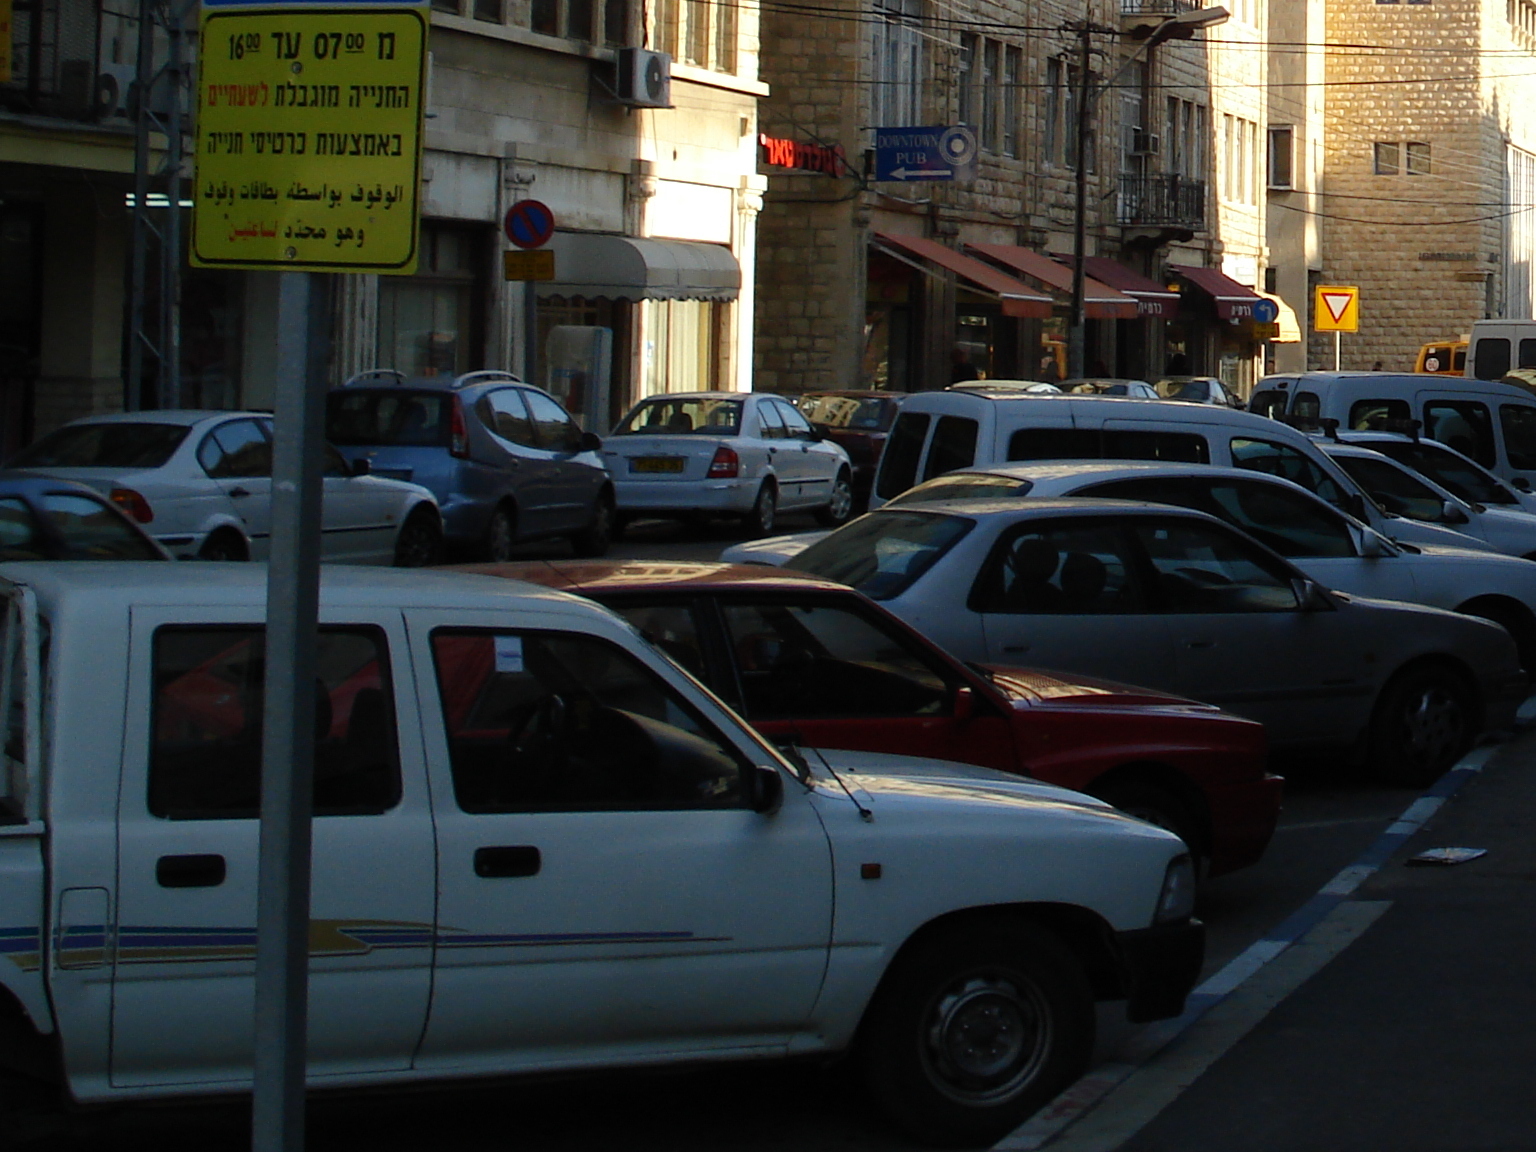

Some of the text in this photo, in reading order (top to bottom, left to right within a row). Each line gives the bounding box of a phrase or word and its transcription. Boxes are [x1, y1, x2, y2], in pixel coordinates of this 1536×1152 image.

[271, 32, 301, 60] עד
[377, 32, 396, 60] מ
[208, 81, 410, 108] החנייה מוגבלת לשעתיים
[207, 131, 403, 157] באמצעות כרטיסי חנייה
[877, 133, 939, 149] DOWNTOWN
[896, 151, 927, 165] PUB
[204, 180, 235, 207] وقوف
[349, 184, 404, 209] الوقوف
[334, 227, 365, 248] وهو
